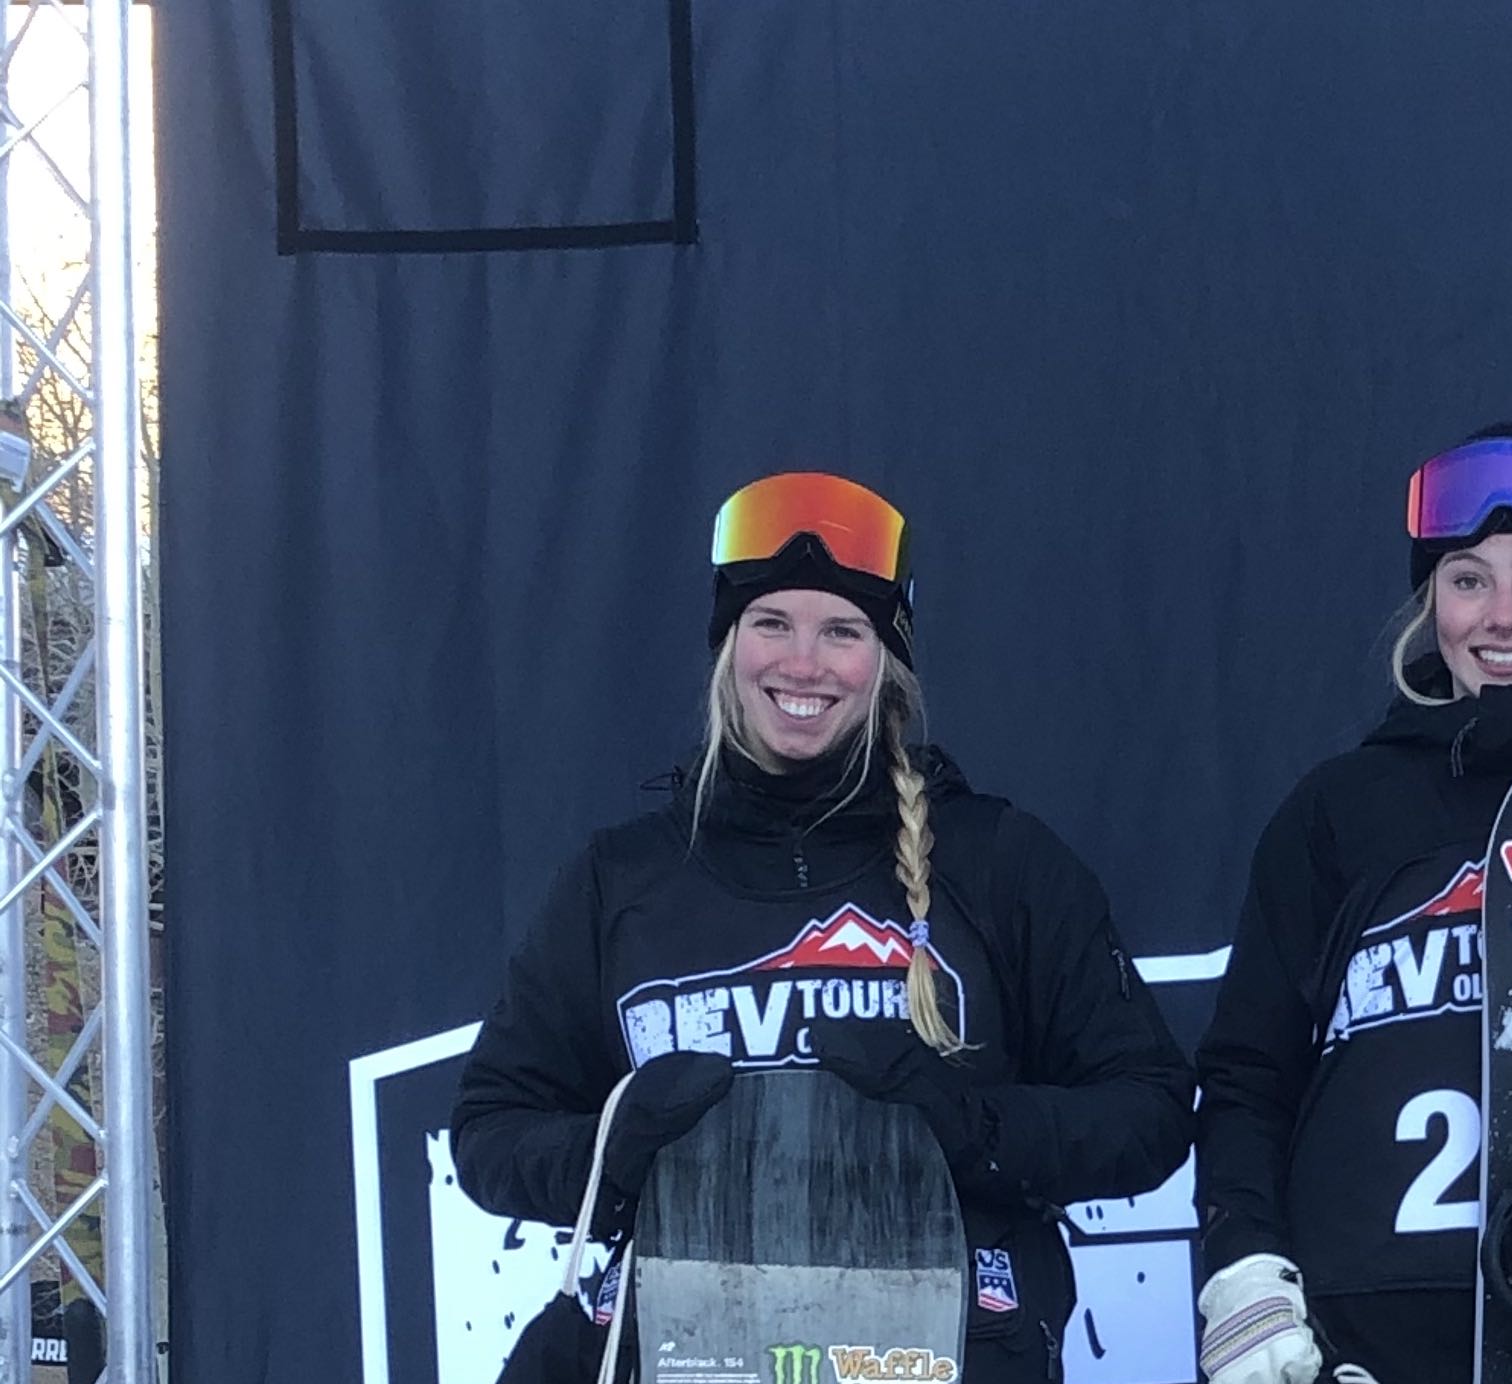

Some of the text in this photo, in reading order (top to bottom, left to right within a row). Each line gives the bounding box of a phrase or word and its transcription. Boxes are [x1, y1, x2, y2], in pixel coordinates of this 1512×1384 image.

[625, 980, 793, 1068] REV
[796, 978, 911, 1019] TOUR
[831, 1348, 954, 1380] Waffle
